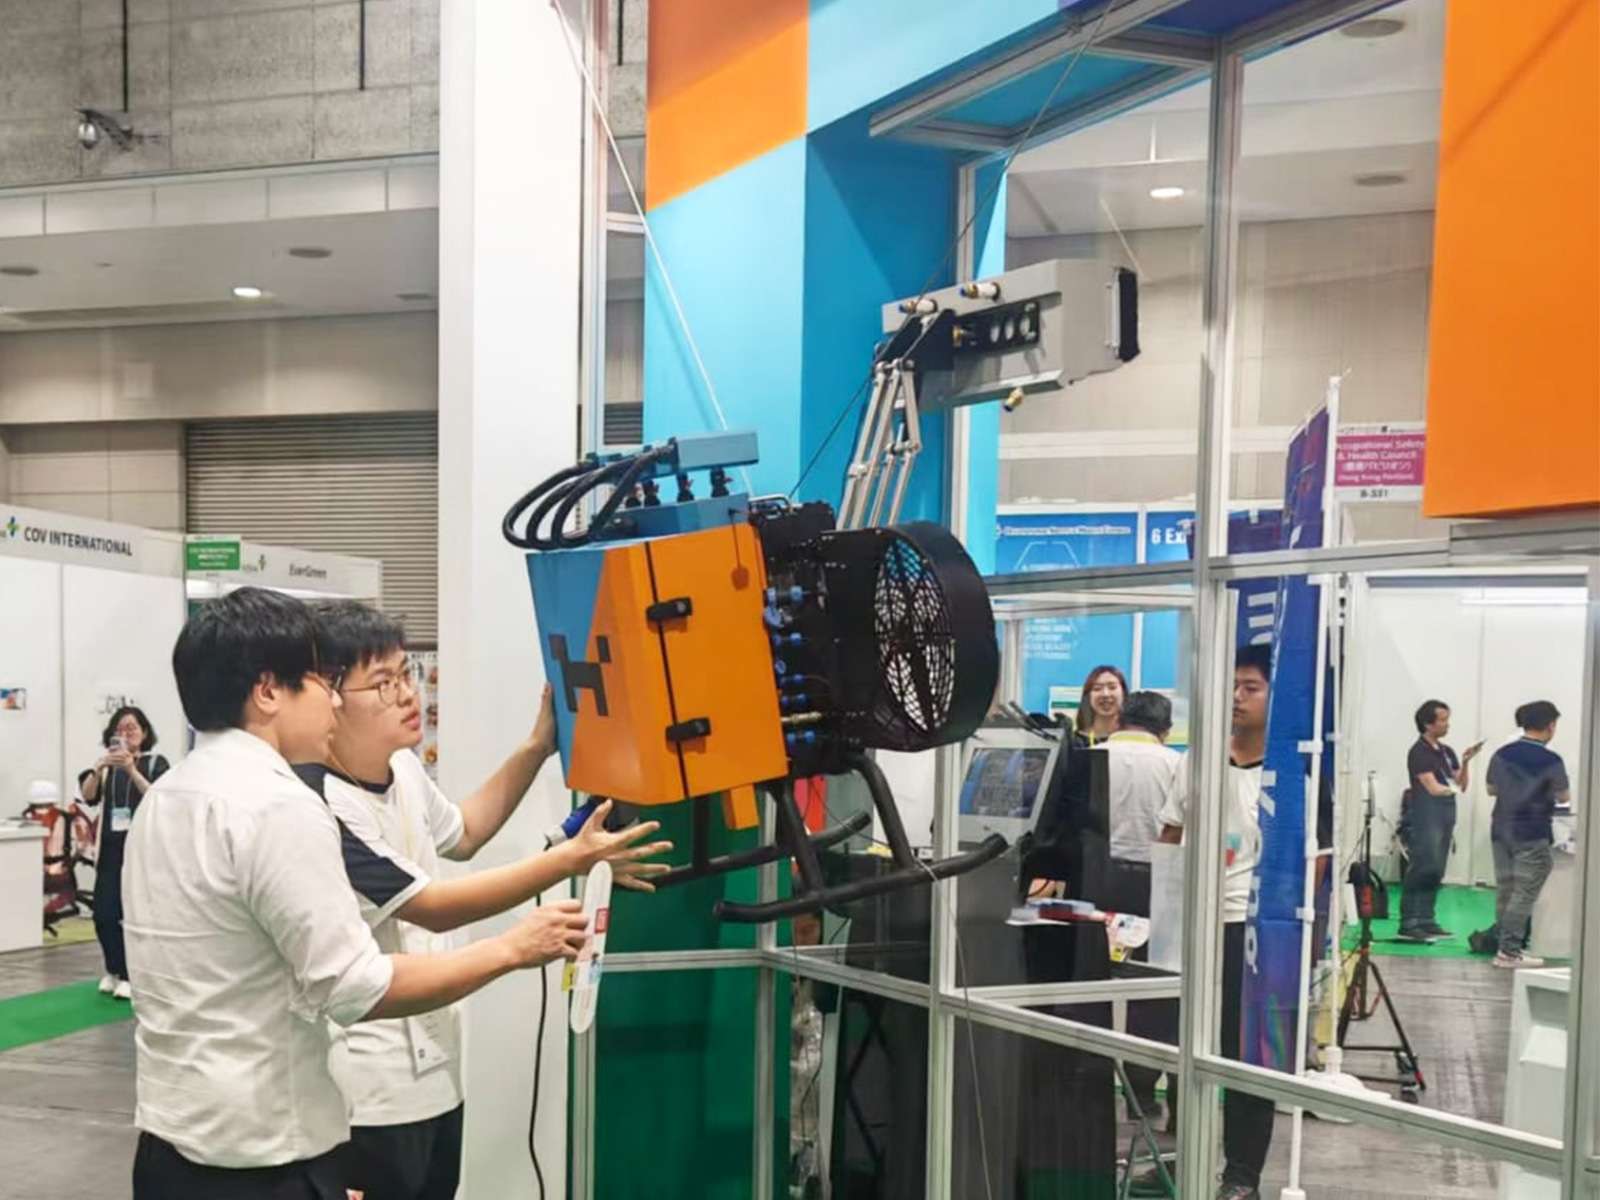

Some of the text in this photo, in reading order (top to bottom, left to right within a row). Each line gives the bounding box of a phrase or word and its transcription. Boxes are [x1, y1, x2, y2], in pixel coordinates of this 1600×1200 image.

[1337, 442, 1393, 452] ccupational
[24, 526, 133, 557] COV INTERNATIONAL
[1151, 527, 1161, 545] 6
